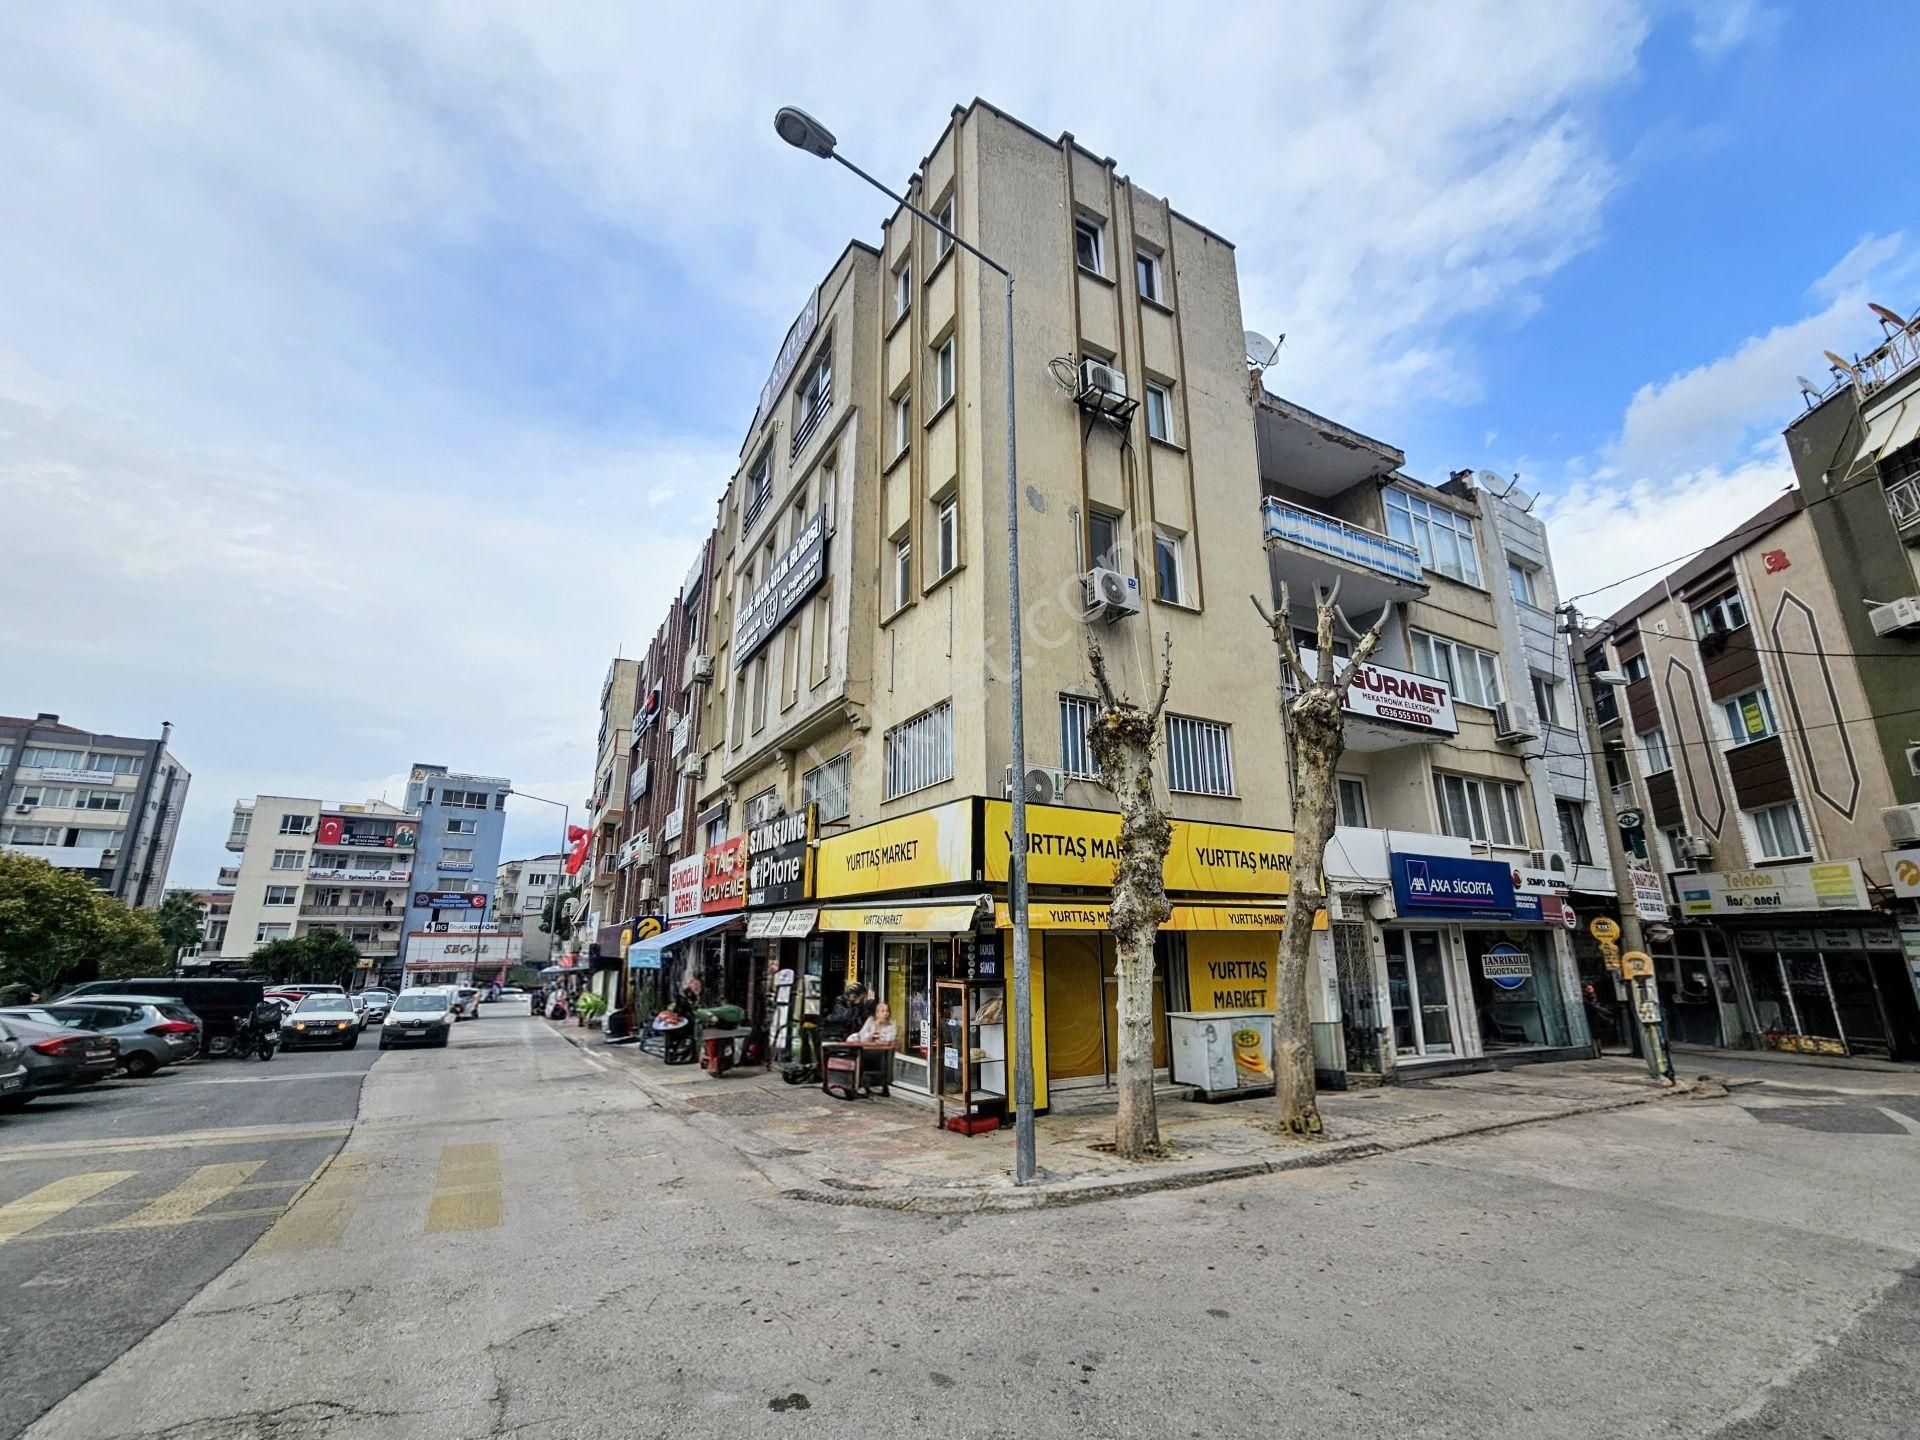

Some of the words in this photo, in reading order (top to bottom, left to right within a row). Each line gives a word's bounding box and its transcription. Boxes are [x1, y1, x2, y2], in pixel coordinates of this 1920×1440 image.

[790, 516, 822, 569] BÜROSU
[1351, 666, 1447, 707] GÜRMET
[1380, 706, 1398, 718] 0536
[1399, 709, 1411, 720] 555
[1411, 713, 1421, 722] 11
[1421, 715, 1430, 724] 11
[749, 812, 806, 855] SAMSUNG
[846, 849, 881, 871] YURTTAŞ
[882, 839, 919, 865] MARKET
[1196, 847, 1257, 873] YURTTAŞ
[1259, 853, 1292, 872] MARK
[759, 855, 799, 888] iPhone
[1724, 872, 1773, 889] Telefon
[1430, 879, 1452, 893] AXA
[1453, 877, 1494, 896] SİGORTA
[1726, 891, 1782, 907] Hasanesi
[863, 915, 884, 927] YURTTAŞ
[884, 914, 903, 925] MARKET
[1049, 909, 1096, 925] YURTTAŞ
[1229, 913, 1263, 927] YURTTAŞ
[1482, 955, 1529, 966] TANRIKULU
[1208, 961, 1268, 983] YURTTAŞ
[1213, 989, 1268, 1009] MARKET
